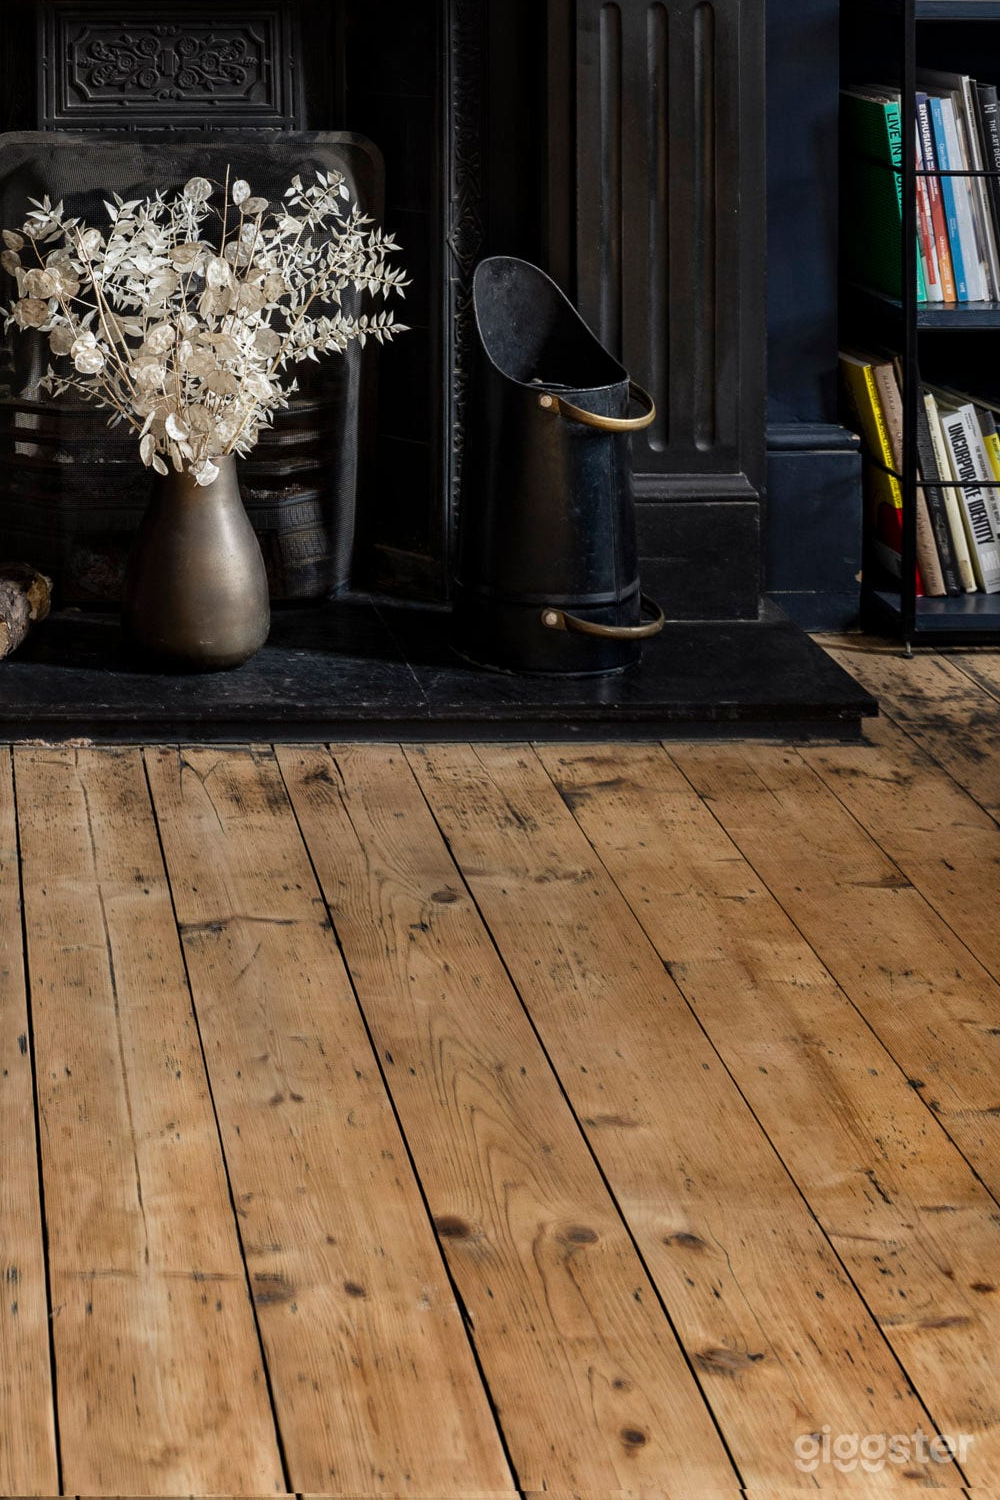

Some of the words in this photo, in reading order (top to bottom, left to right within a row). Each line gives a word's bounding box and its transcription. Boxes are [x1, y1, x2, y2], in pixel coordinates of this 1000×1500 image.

[886, 112, 898, 139] LIVE
[919, 103, 933, 161] ENTHUSIASM
[989, 120, 997, 132] THE
[891, 141, 900, 156] IN
[991, 134, 999, 147] ART
[948, 422, 982, 499] UNCORPORTE
[967, 501, 995, 547] IDENTITY
